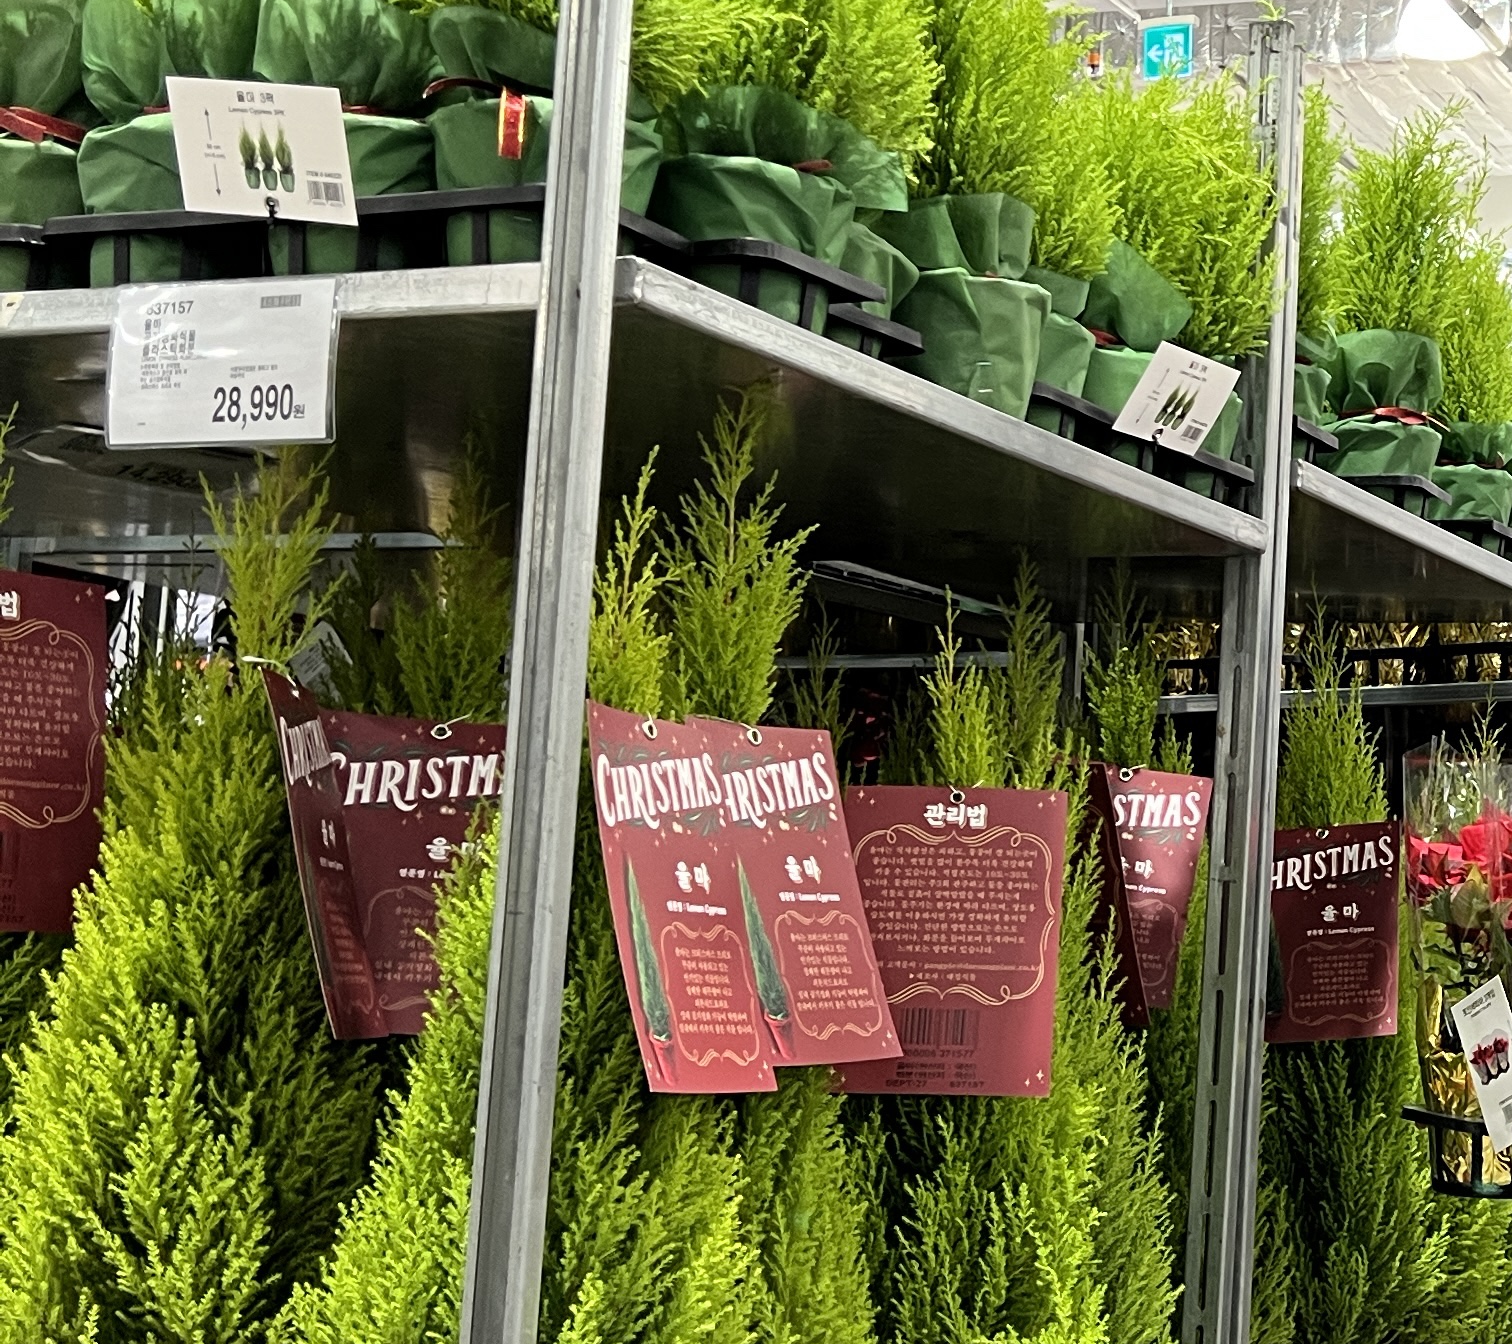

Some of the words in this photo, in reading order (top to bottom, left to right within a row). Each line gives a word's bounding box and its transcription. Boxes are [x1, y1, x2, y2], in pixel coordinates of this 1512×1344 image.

[212, 384, 305, 430] 28,990원
[331, 752, 505, 811] HRISTM
[597, 752, 723, 830] CHRISTMAS
[924, 803, 987, 829] 관리법
[675, 861, 711, 895] 율마
[785, 855, 821, 884] 율마
[1321, 903, 1361, 922] 율마
